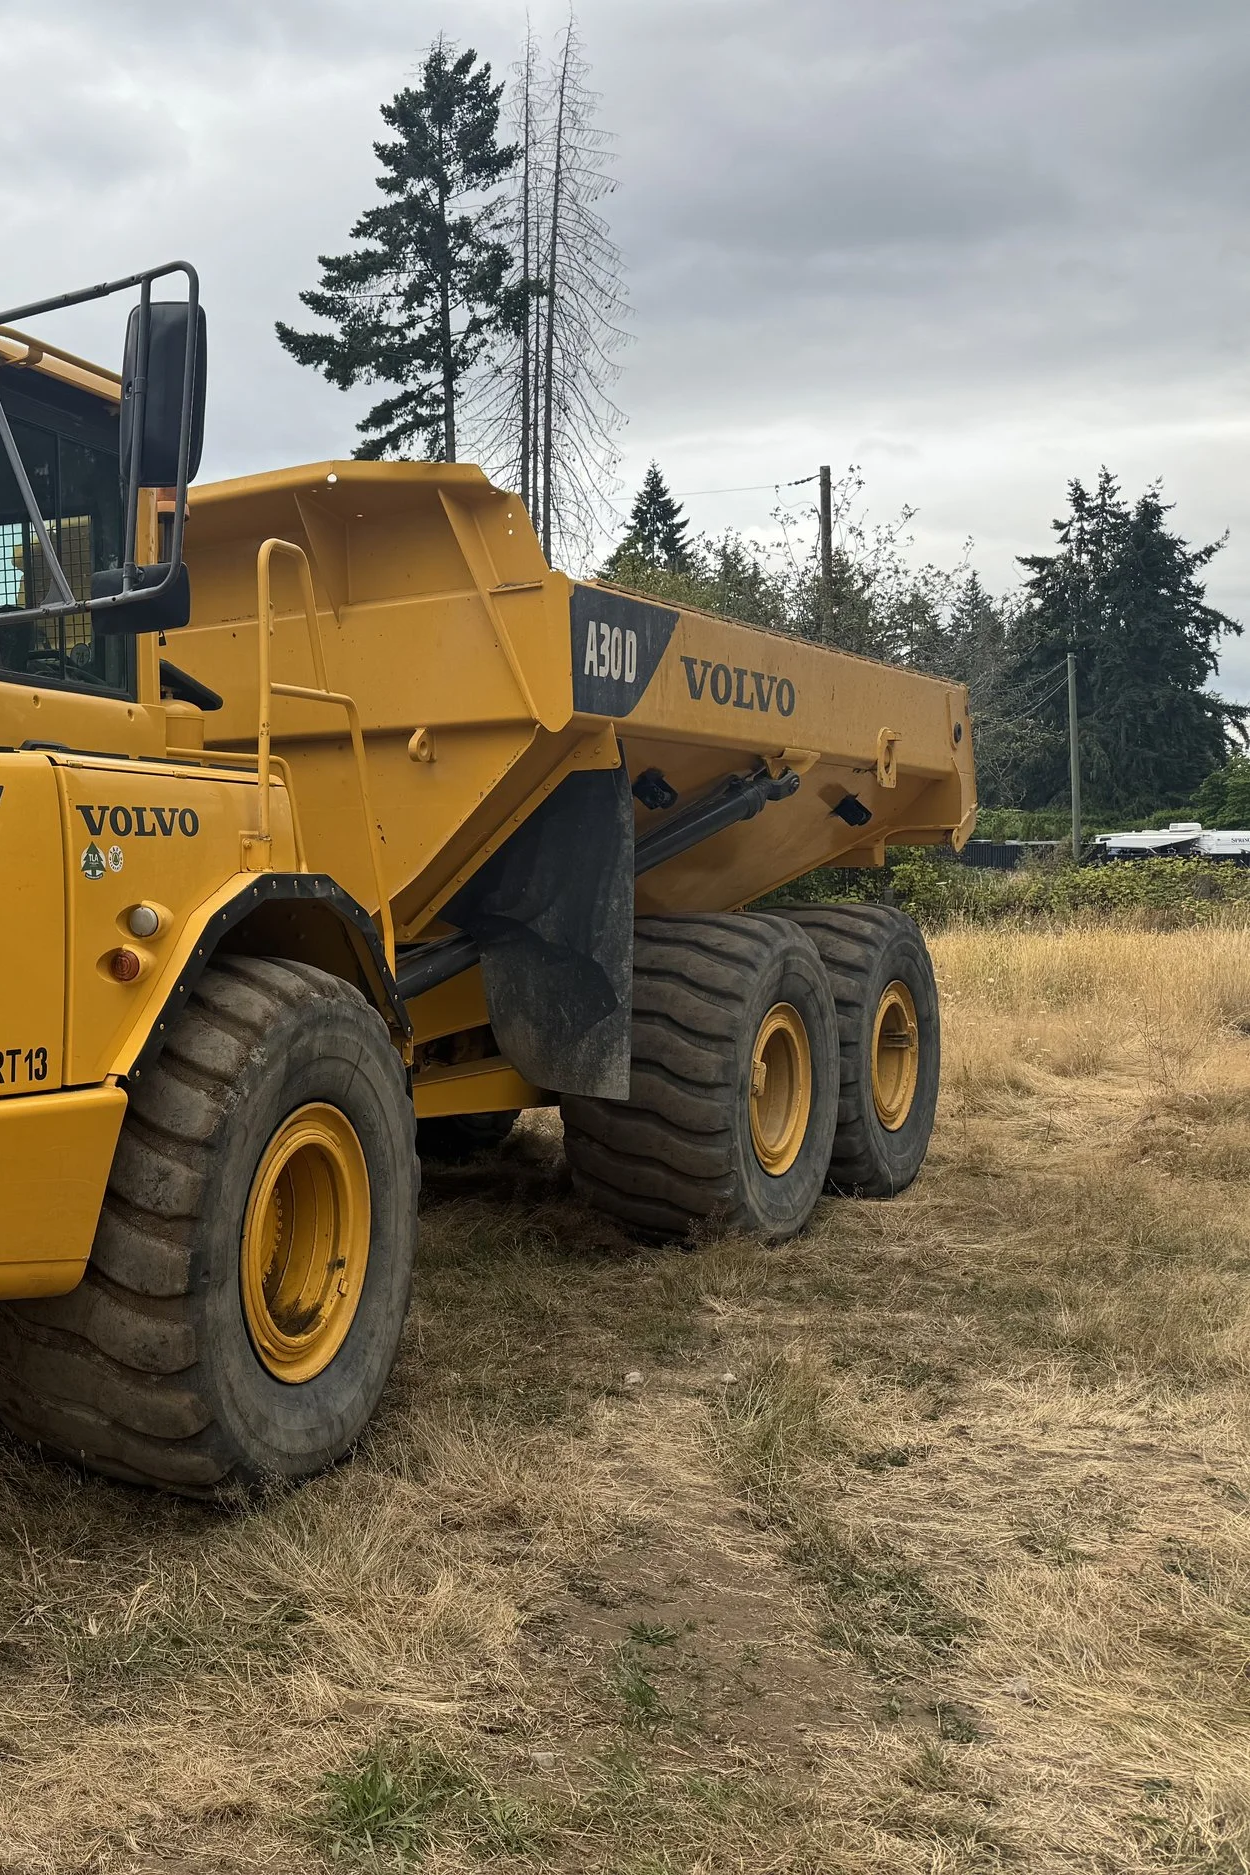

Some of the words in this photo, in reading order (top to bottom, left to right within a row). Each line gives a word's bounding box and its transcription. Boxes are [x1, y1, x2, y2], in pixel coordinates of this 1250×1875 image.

[584, 620, 637, 683] A30D
[680, 655, 796, 717] VOLVO
[76, 805, 199, 837] VOLVO
